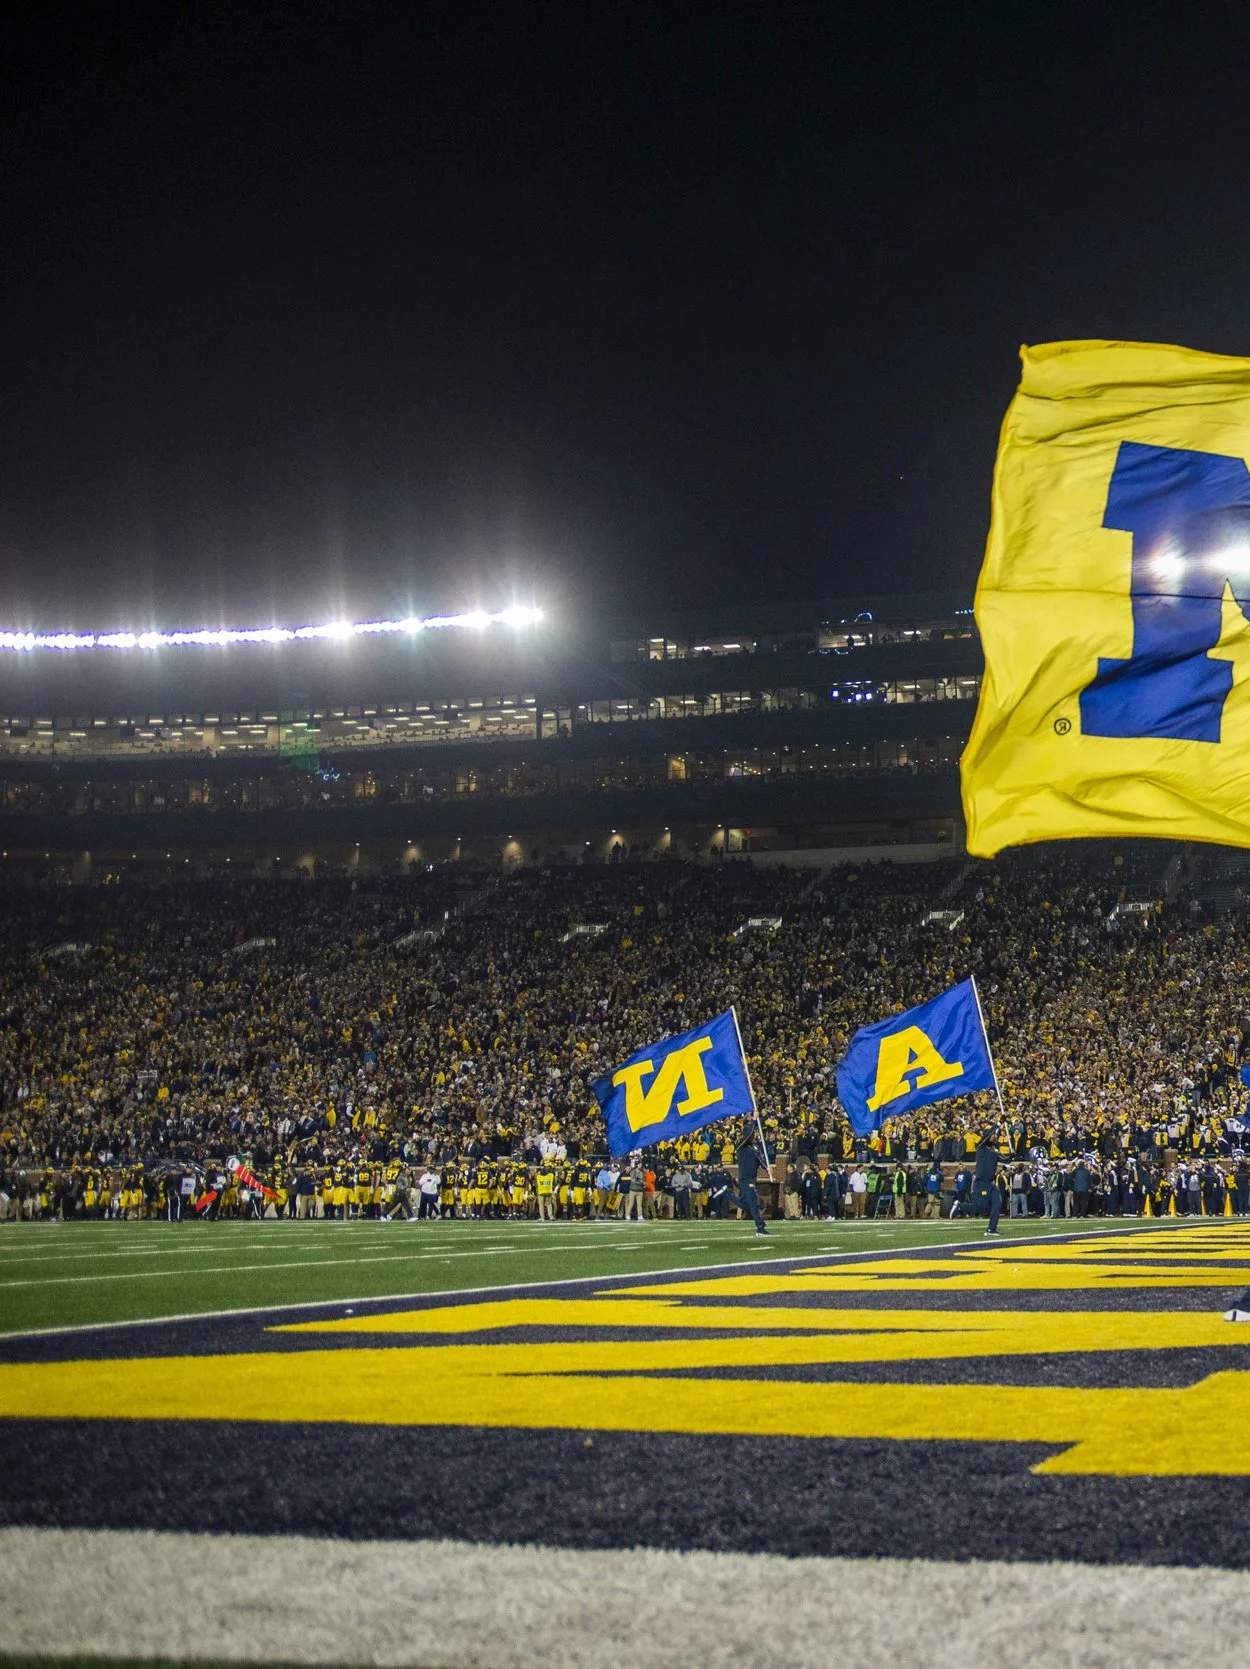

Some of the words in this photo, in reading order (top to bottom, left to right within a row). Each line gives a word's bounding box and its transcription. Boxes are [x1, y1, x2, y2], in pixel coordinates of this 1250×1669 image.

[866, 1025, 964, 1112] A
[386, 1169, 399, 1180] 97
[477, 1174, 489, 1185] 12
